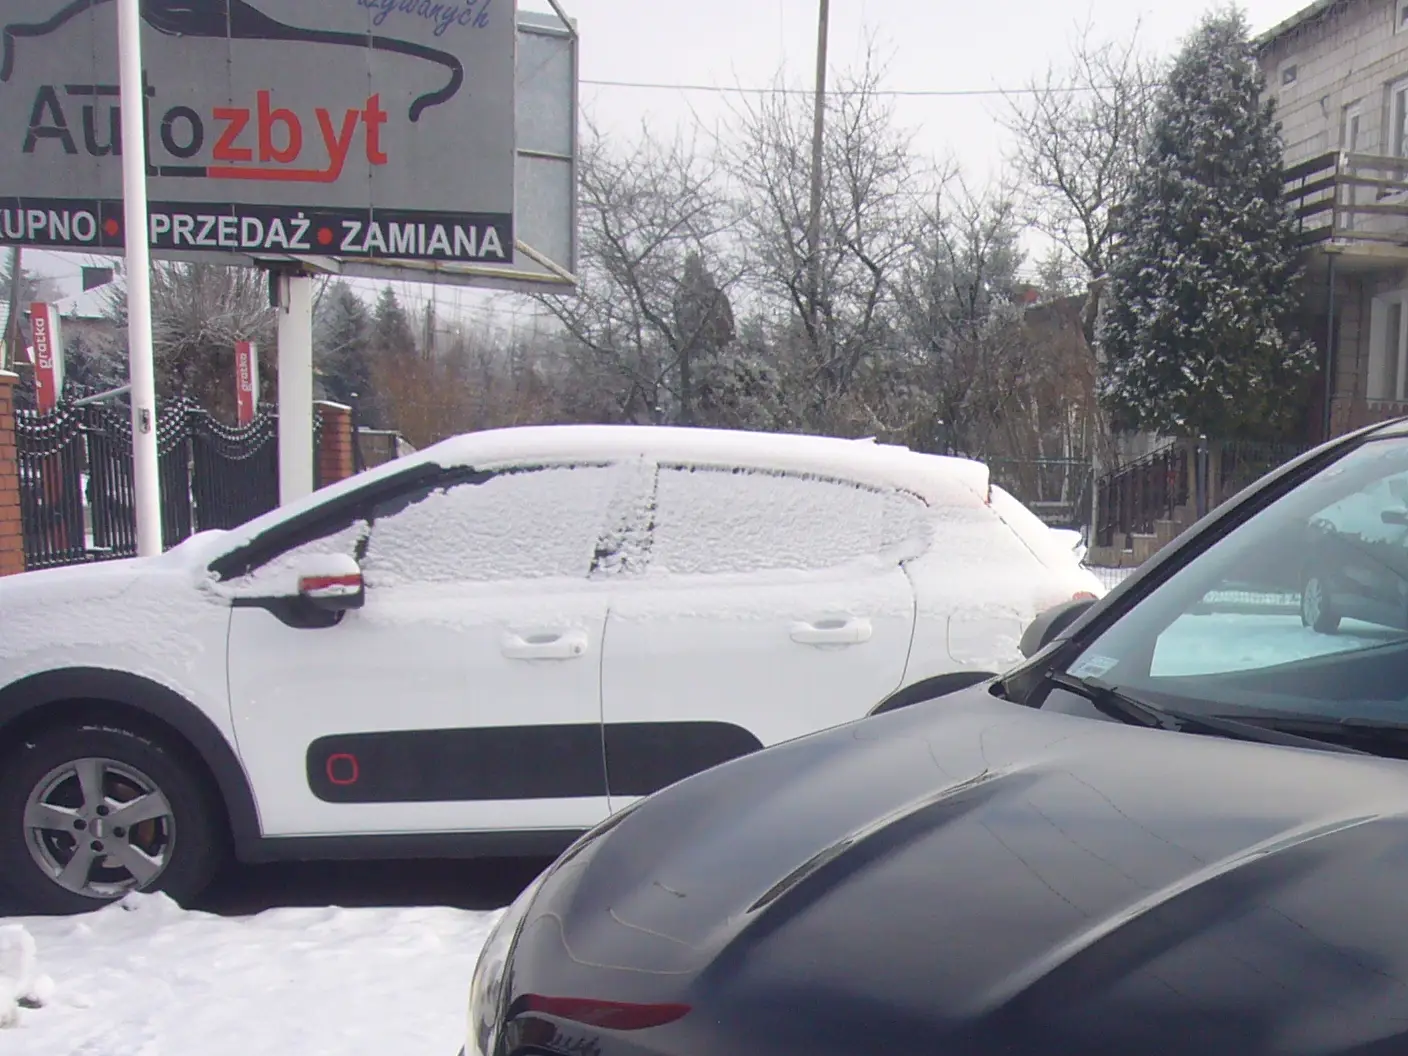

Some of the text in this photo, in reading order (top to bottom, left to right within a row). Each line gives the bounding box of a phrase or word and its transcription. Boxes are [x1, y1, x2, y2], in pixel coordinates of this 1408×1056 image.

[0, 208, 506, 258] UPNO PRZEDAŻ ZAMIANA
[34, 317, 53, 369] gratka
